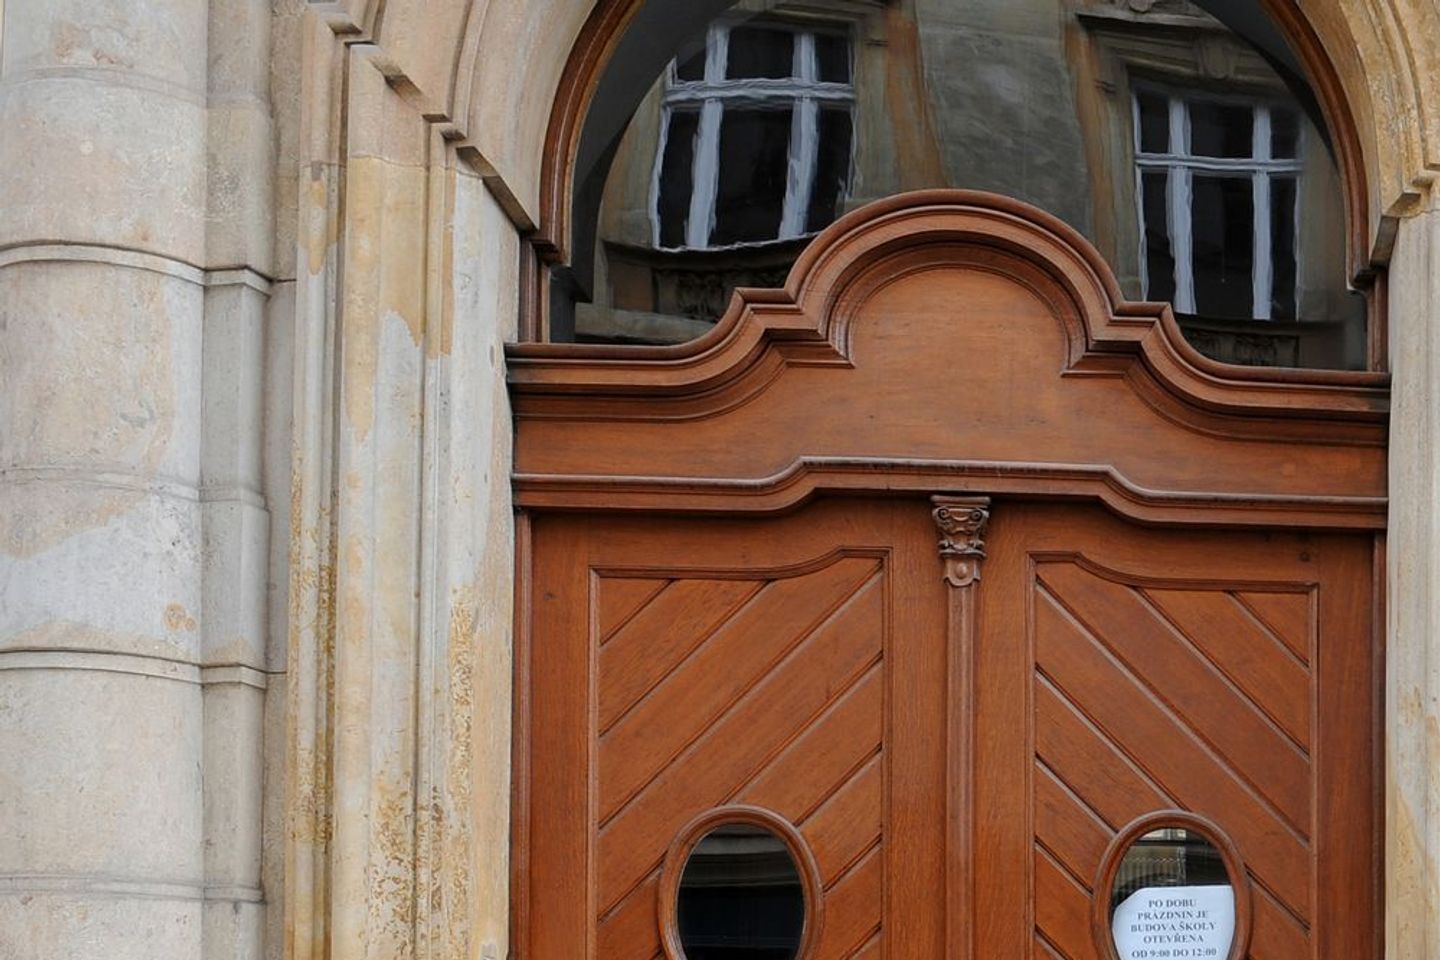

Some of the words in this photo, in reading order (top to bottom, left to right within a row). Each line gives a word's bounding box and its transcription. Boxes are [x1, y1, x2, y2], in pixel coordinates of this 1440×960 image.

[1148, 899, 1163, 908] PO
[1166, 899, 1196, 908] DOBU
[1137, 910, 1193, 920] PRÁZDNIN
[1196, 910, 1208, 919] JE
[1131, 923, 1176, 932] BUDOVA
[1179, 920, 1216, 931] ŠKOLY
[1143, 933, 1204, 944] OTEVŘENA
[1131, 950, 1148, 959] OD
[1150, 949, 1170, 958] 9:00
[1172, 949, 1189, 958] DO
[1192, 948, 1217, 957] 12:00
